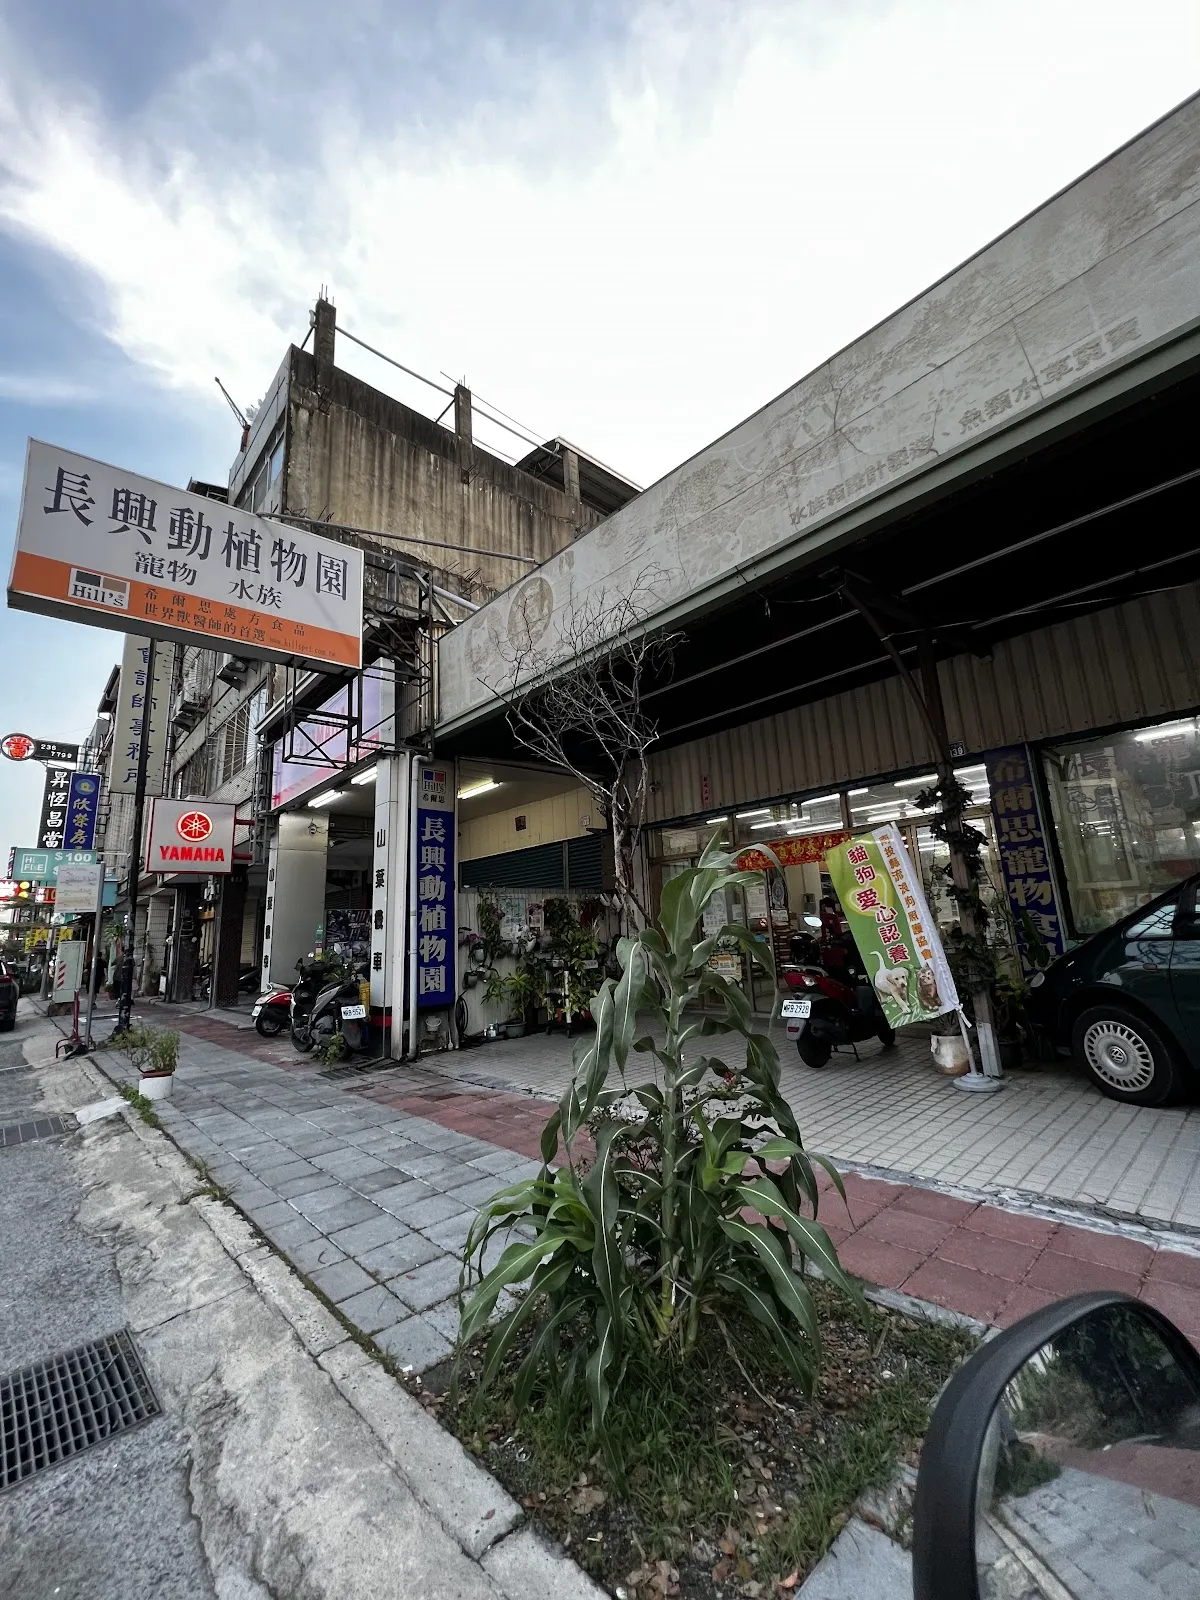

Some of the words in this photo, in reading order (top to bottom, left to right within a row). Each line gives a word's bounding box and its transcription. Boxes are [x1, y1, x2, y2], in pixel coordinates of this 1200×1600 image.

[44, 467, 348, 601] 長興動植物園
[72, 584, 124, 607] Hill's
[135, 551, 197, 586] 寵物
[229, 579, 282, 609] 水族
[144, 587, 305, 637] 希爾思處方食品
[144, 603, 266, 642] 世界獸醫師的首選
[423, 781, 444, 793] Hill's
[69, 797, 93, 849] 欣榮房
[159, 846, 225, 862] YAMAHA
[419, 817, 446, 995] 長興動植物園
[848, 845, 910, 963] 貓狗愛心認養
